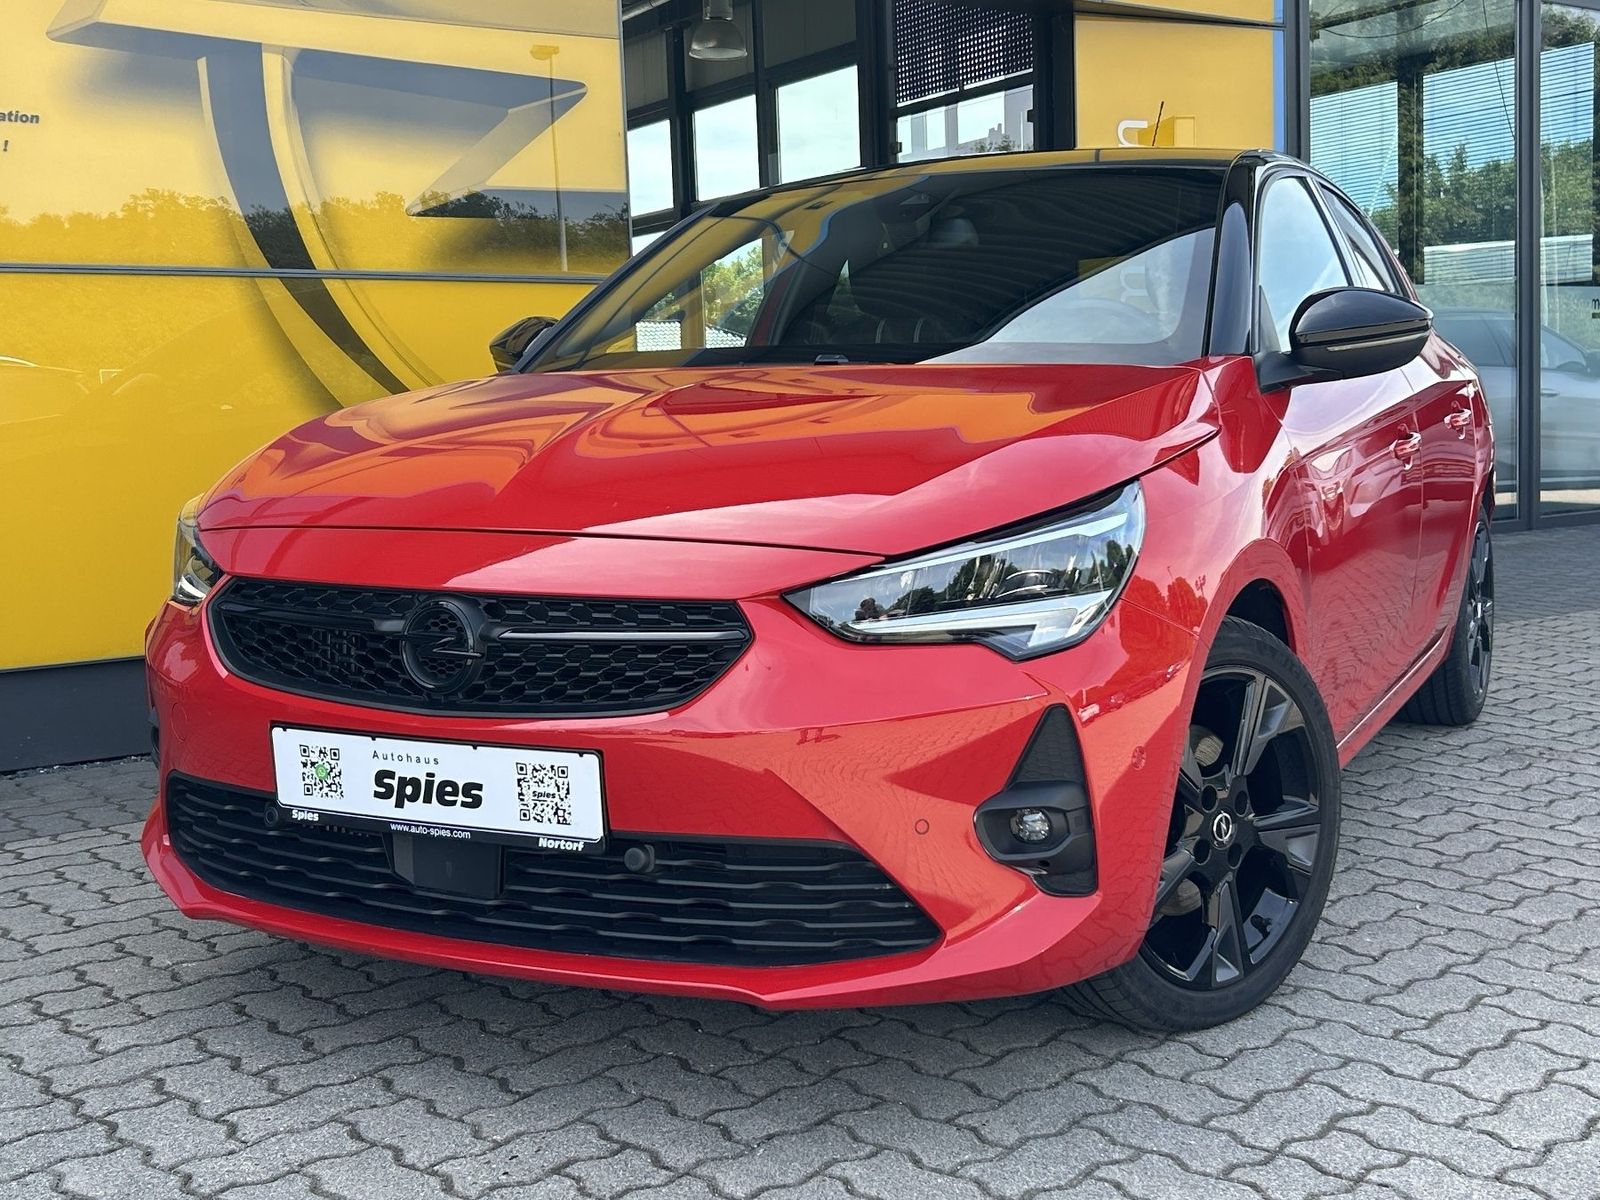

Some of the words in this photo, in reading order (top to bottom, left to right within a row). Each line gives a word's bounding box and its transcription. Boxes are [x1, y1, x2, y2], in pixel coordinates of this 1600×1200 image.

[372, 750, 440, 766] Autohaus
[373, 769, 484, 809] Spies
[532, 790, 557, 799] Spies
[291, 809, 320, 822] Spies
[390, 822, 472, 840] www.auto-spies.com
[538, 837, 585, 852] Nortorf
